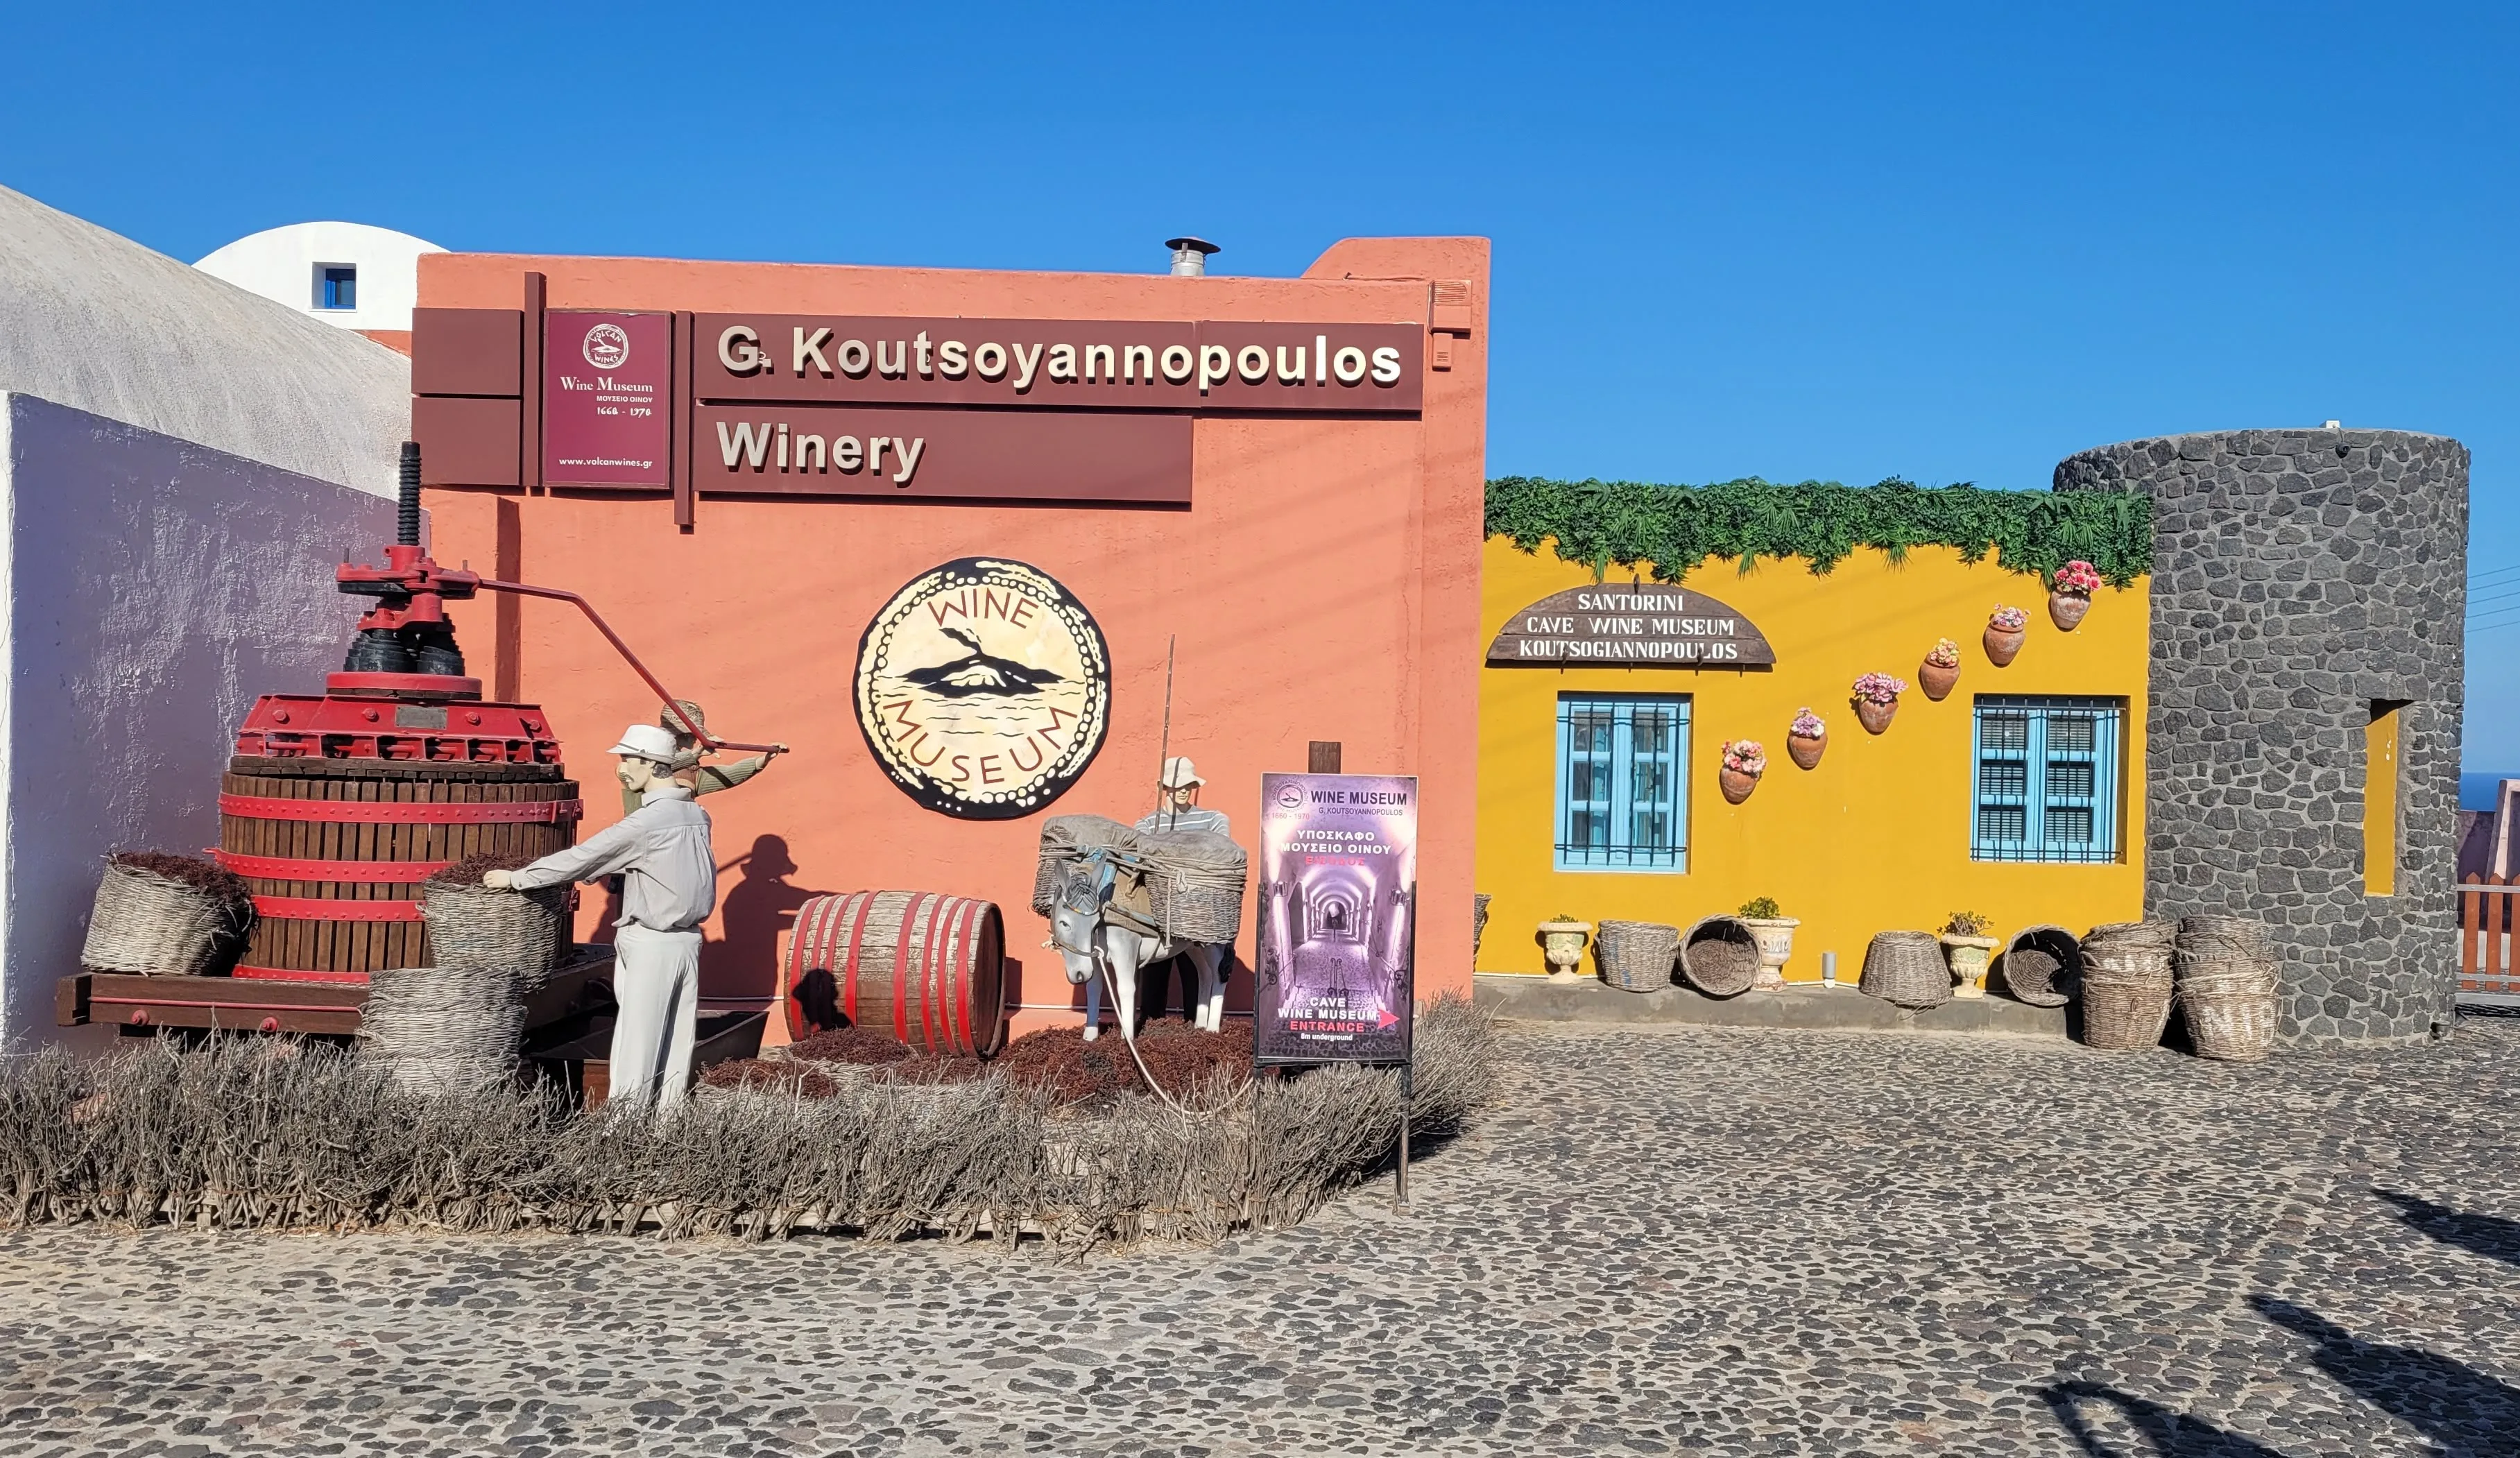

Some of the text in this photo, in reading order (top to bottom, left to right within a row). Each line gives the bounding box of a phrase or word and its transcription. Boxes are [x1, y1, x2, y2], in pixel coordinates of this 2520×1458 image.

[589, 330, 622, 343] VOLCAN
[594, 353, 619, 363] WINES
[718, 325, 1401, 390] G. Koutsoyannopoulos
[560, 376, 653, 393] Wine Museum
[716, 421, 924, 483] Winery
[559, 456, 653, 469] www.volcanwines.gr
[927, 588, 1039, 629] WINE
[1578, 593, 1683, 612] SANTORINI
[1527, 617, 1734, 636] CAVE WINE MUSEUM
[1520, 640, 1738, 660] KOUTSOGIANNOPOULOS
[882, 699, 1078, 784] MUSEUM
[1311, 790, 1407, 805] WINE MUSEUM
[1319, 807, 1403, 816] G. KOUTSOYANNOPOULOS
[1297, 830, 1375, 841] ΥΠΟΣΚΑΦΟ
[1280, 843, 1391, 855] ΜΟΥΣΕΙΟ ΟΙΝΟΥ
[1310, 997, 1346, 1007] CAVE
[1278, 1008, 1377, 1020] WINE MUSEUM
[1290, 1020, 1364, 1032] ENTRANCE
